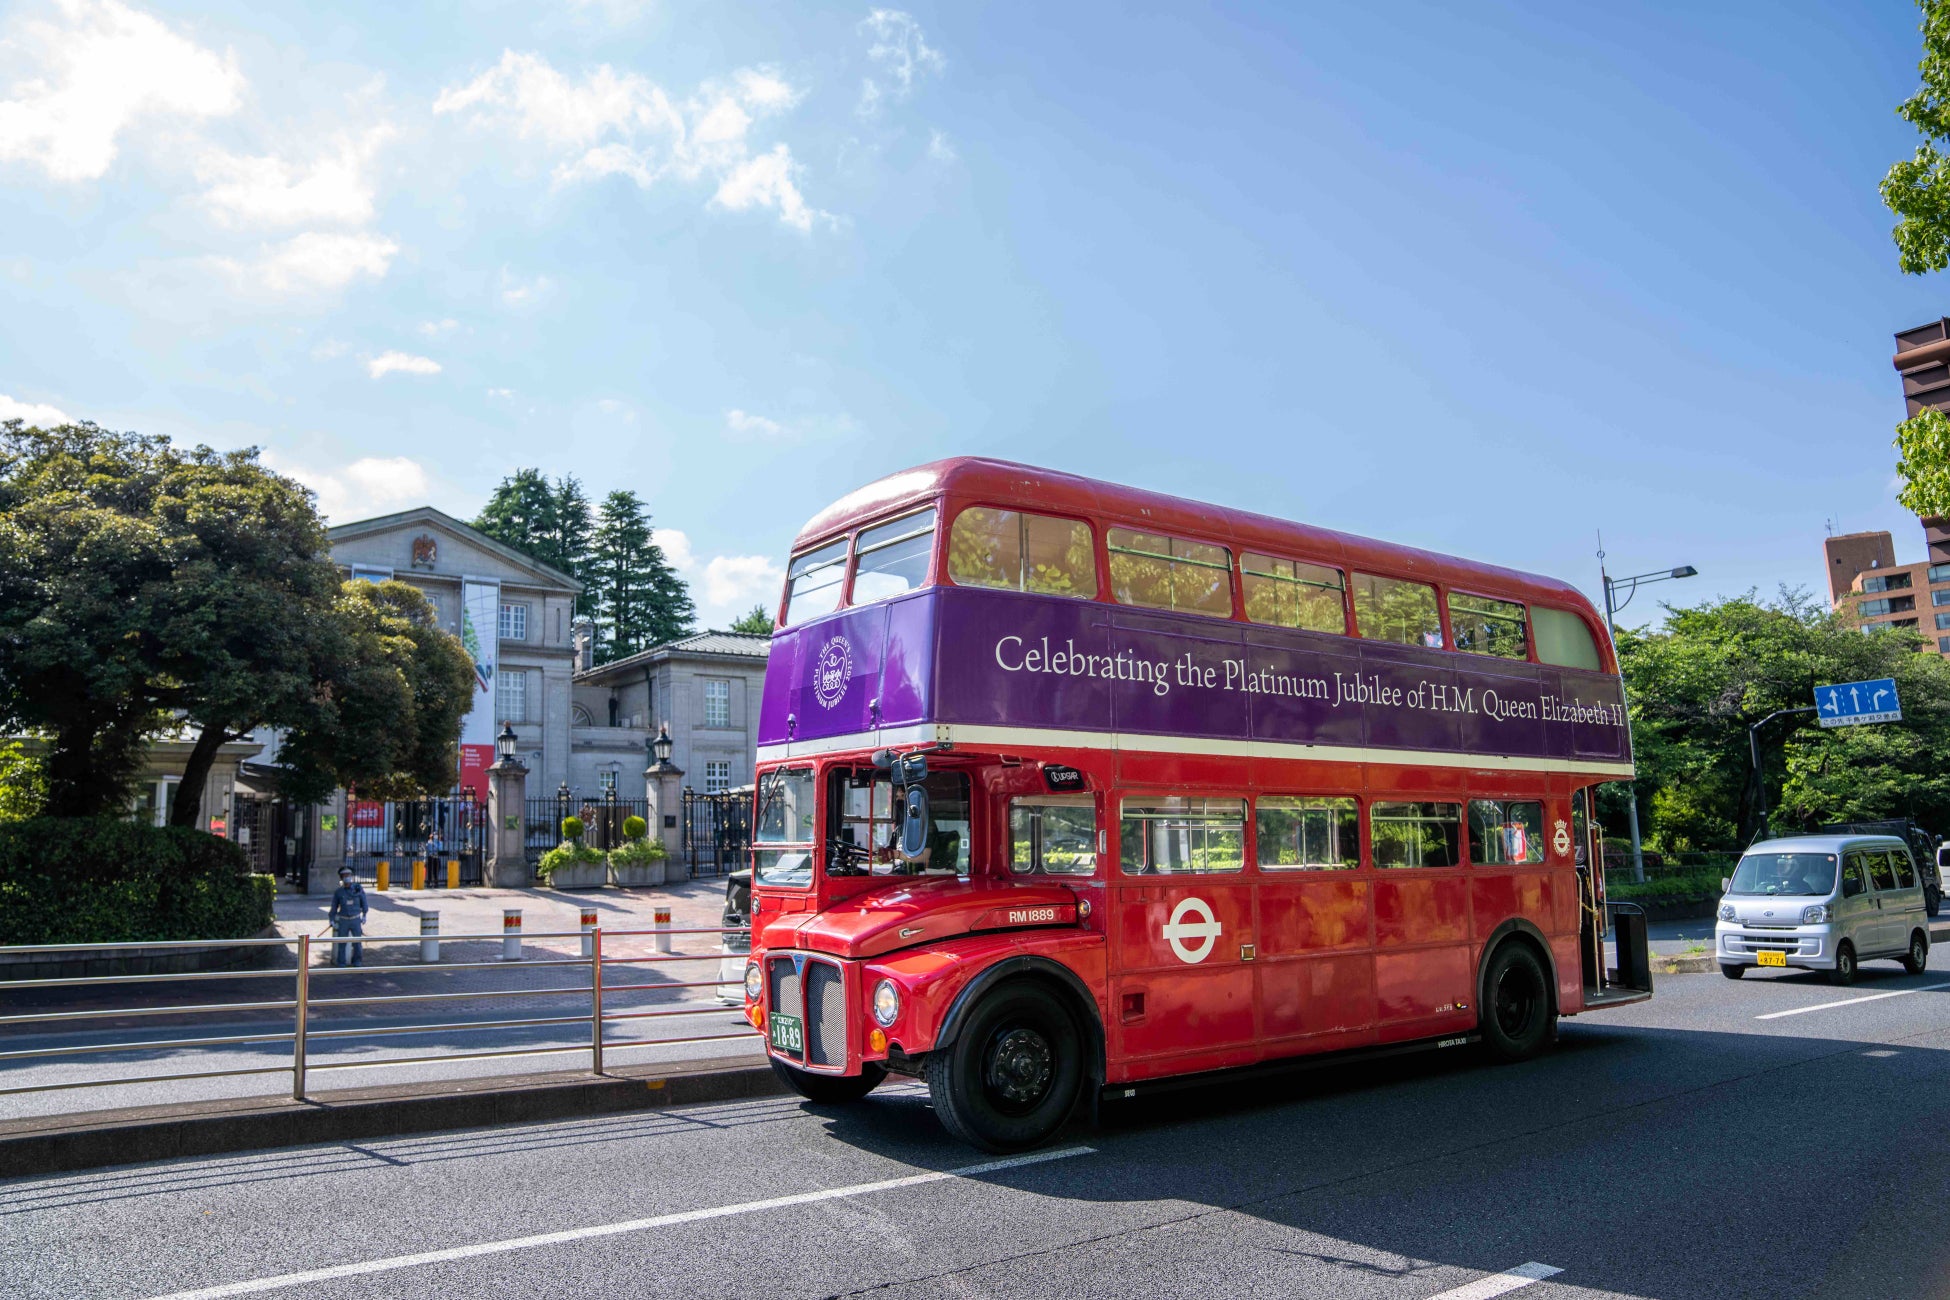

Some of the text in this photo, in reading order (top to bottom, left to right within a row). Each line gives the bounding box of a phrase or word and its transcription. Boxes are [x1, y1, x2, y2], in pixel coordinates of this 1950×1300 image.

[819, 636, 851, 658] THE QUEEN'S
[813, 668, 828, 708] PLATINUM
[827, 683, 848, 711] JUBILEE
[995, 635, 1624, 727] Celebrating the Platinum Jubilee of H.M. Queen Elizabeth II
[1009, 909, 1055, 923] RM 1889
[777, 1025, 801, 1048] 18-89
